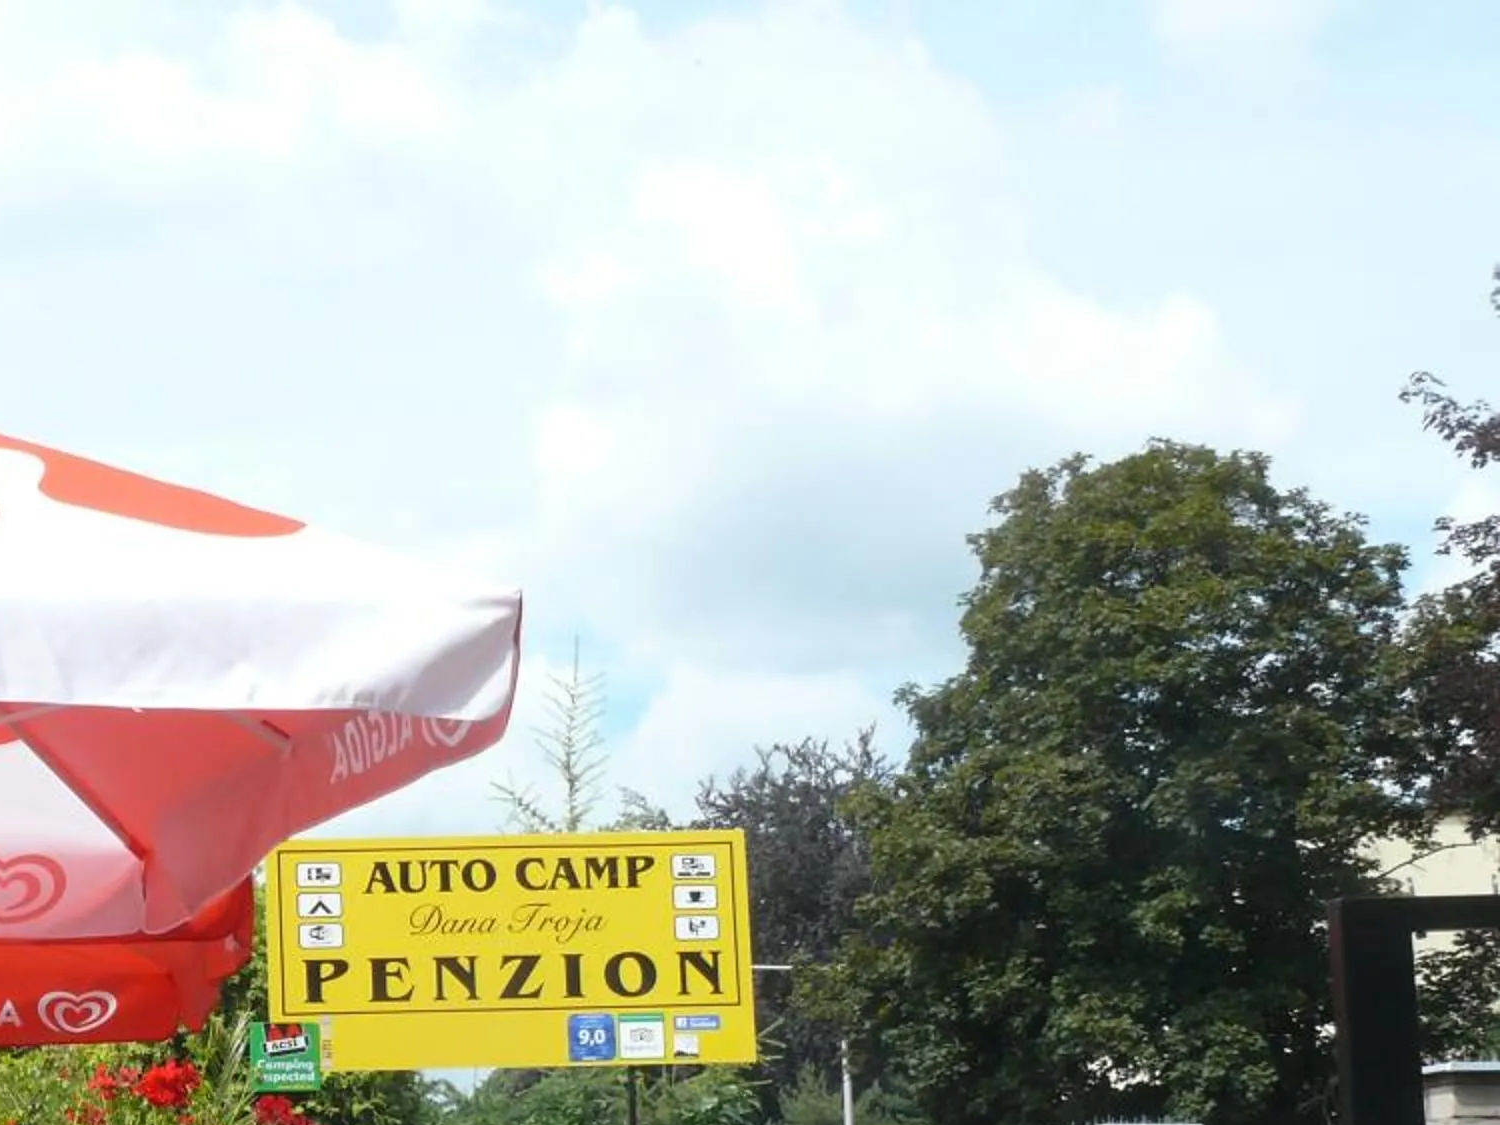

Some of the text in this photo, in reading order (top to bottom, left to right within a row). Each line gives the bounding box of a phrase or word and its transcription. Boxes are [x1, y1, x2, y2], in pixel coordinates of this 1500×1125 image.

[365, 855, 655, 893] AUTO CAMP
[409, 903, 607, 944] Dana Troja
[301, 949, 724, 1004] PENZION
